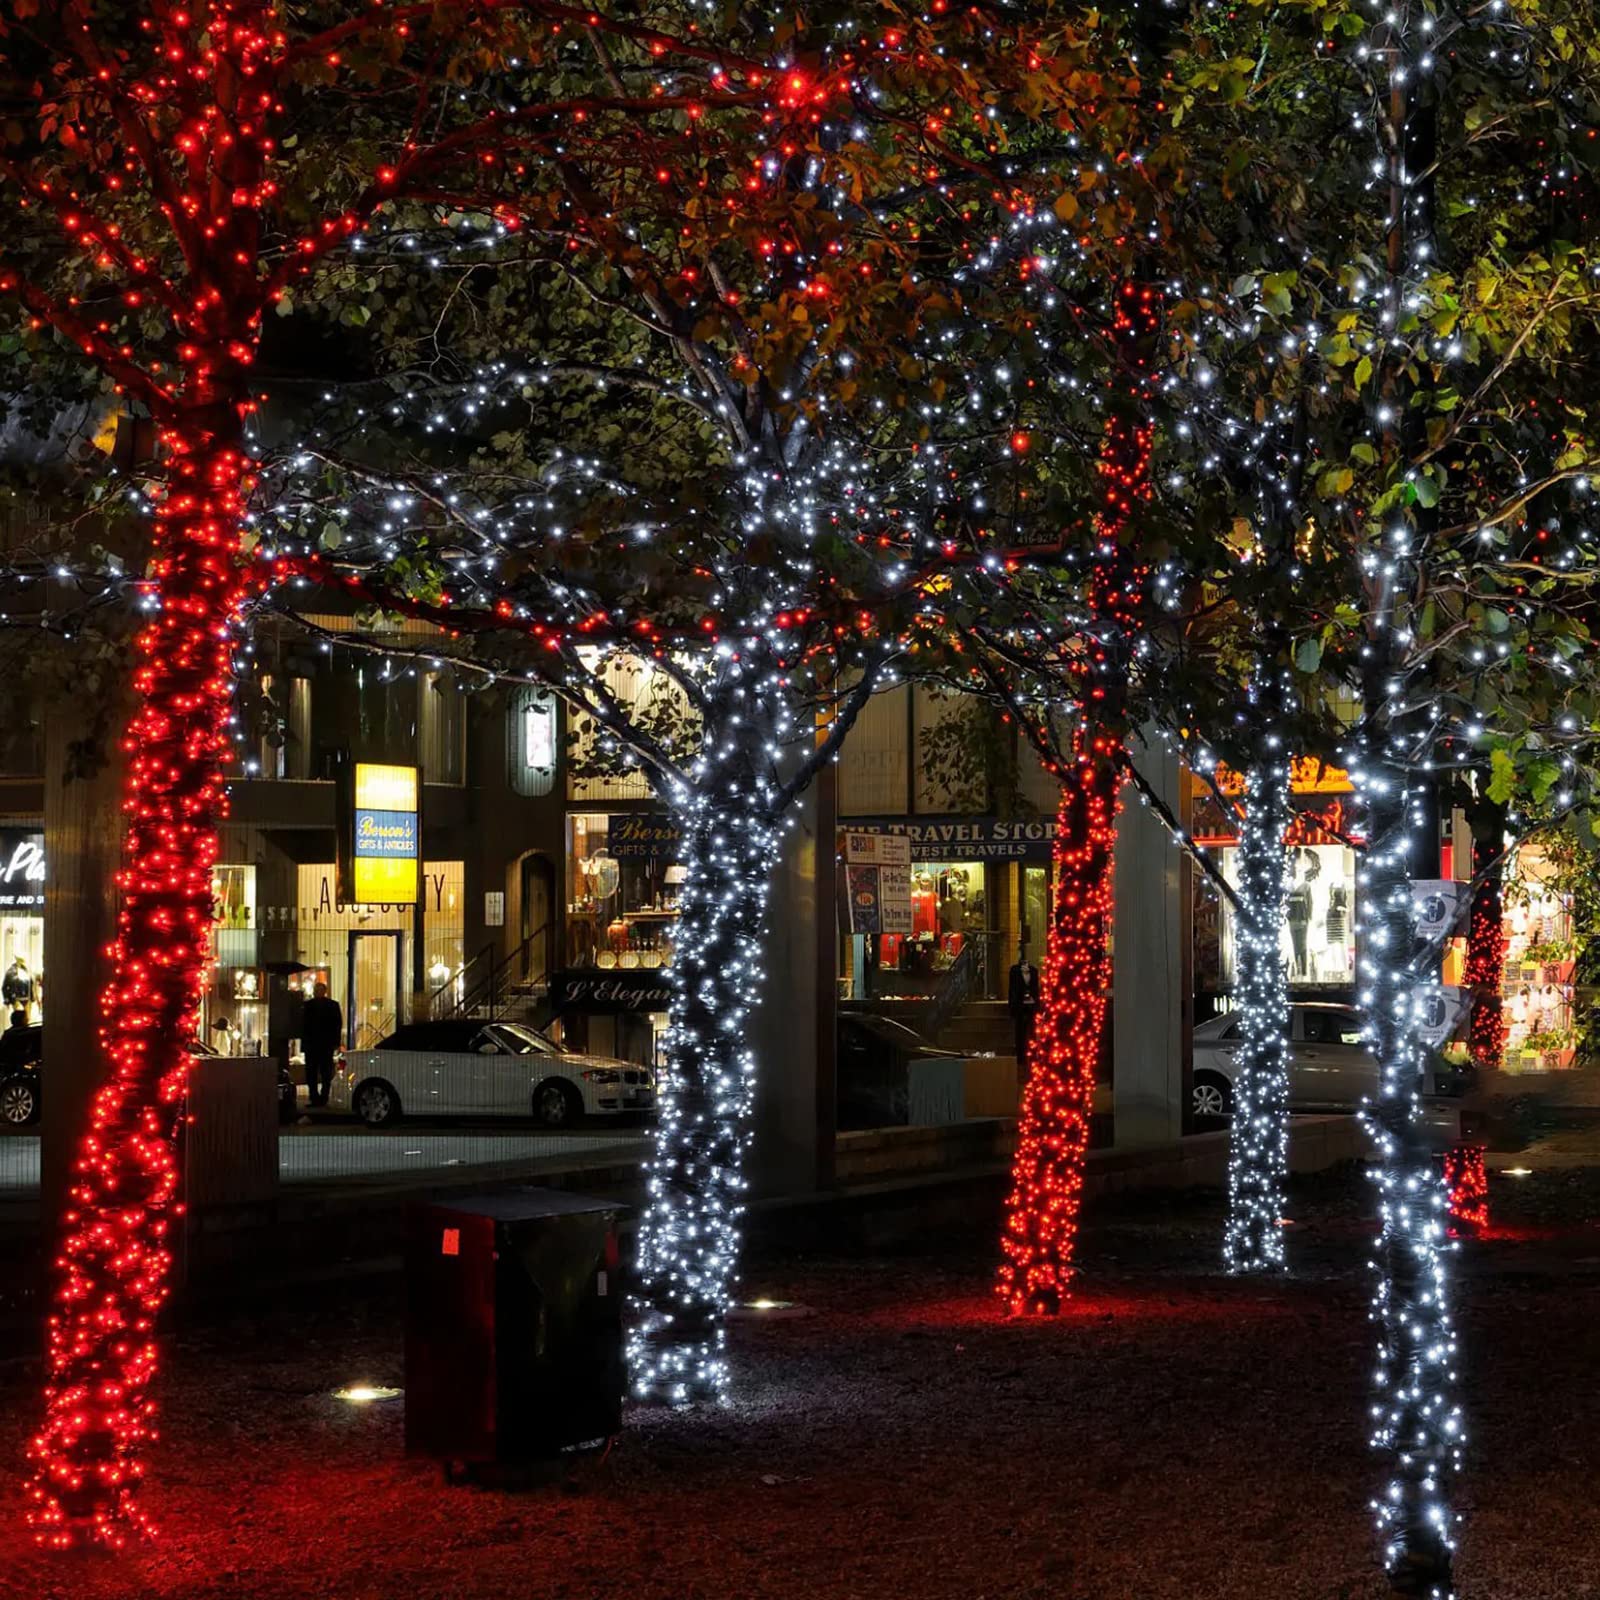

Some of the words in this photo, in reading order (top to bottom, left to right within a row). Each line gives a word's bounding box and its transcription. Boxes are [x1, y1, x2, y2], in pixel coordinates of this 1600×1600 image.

[358, 816, 414, 838] Berson's
[888, 823, 984, 842] TRAVEL
[992, 821, 1060, 840] STOP
[359, 839, 377, 849] GIFTS
[954, 843, 1027, 857] TRAVELS
[612, 845, 647, 856] GIFTS
[650, 845, 661, 856] &
[16, 895, 35, 905] AND
